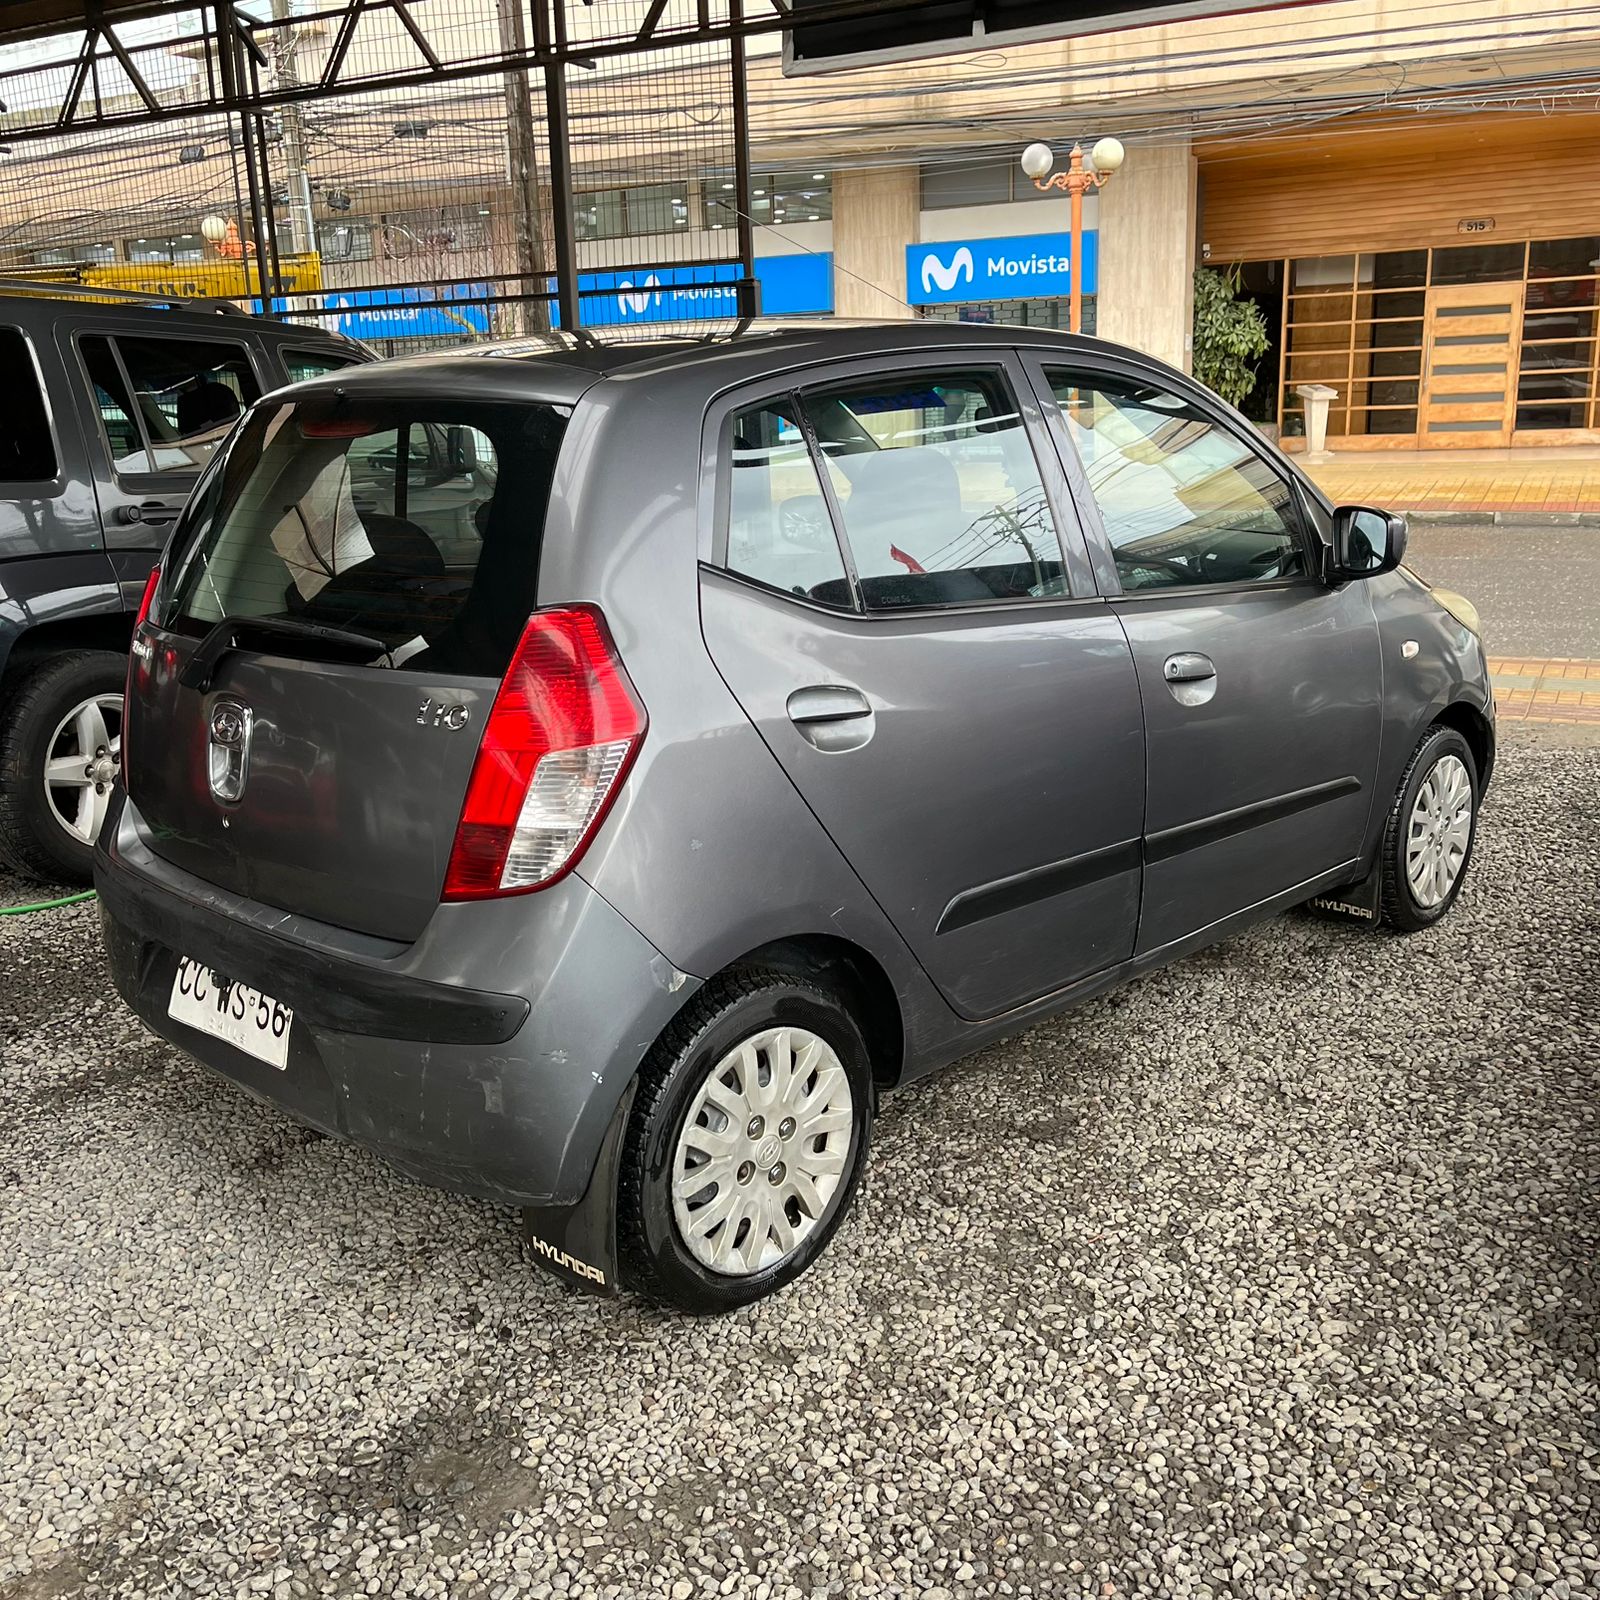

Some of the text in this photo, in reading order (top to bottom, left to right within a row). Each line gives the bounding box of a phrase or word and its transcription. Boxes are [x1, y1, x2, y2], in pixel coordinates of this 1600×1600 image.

[1466, 221, 1486, 232] 515
[987, 253, 1070, 278] Movista
[1315, 898, 1373, 919] HYUNDAI
[532, 1235, 606, 1286] HYUNDAI
